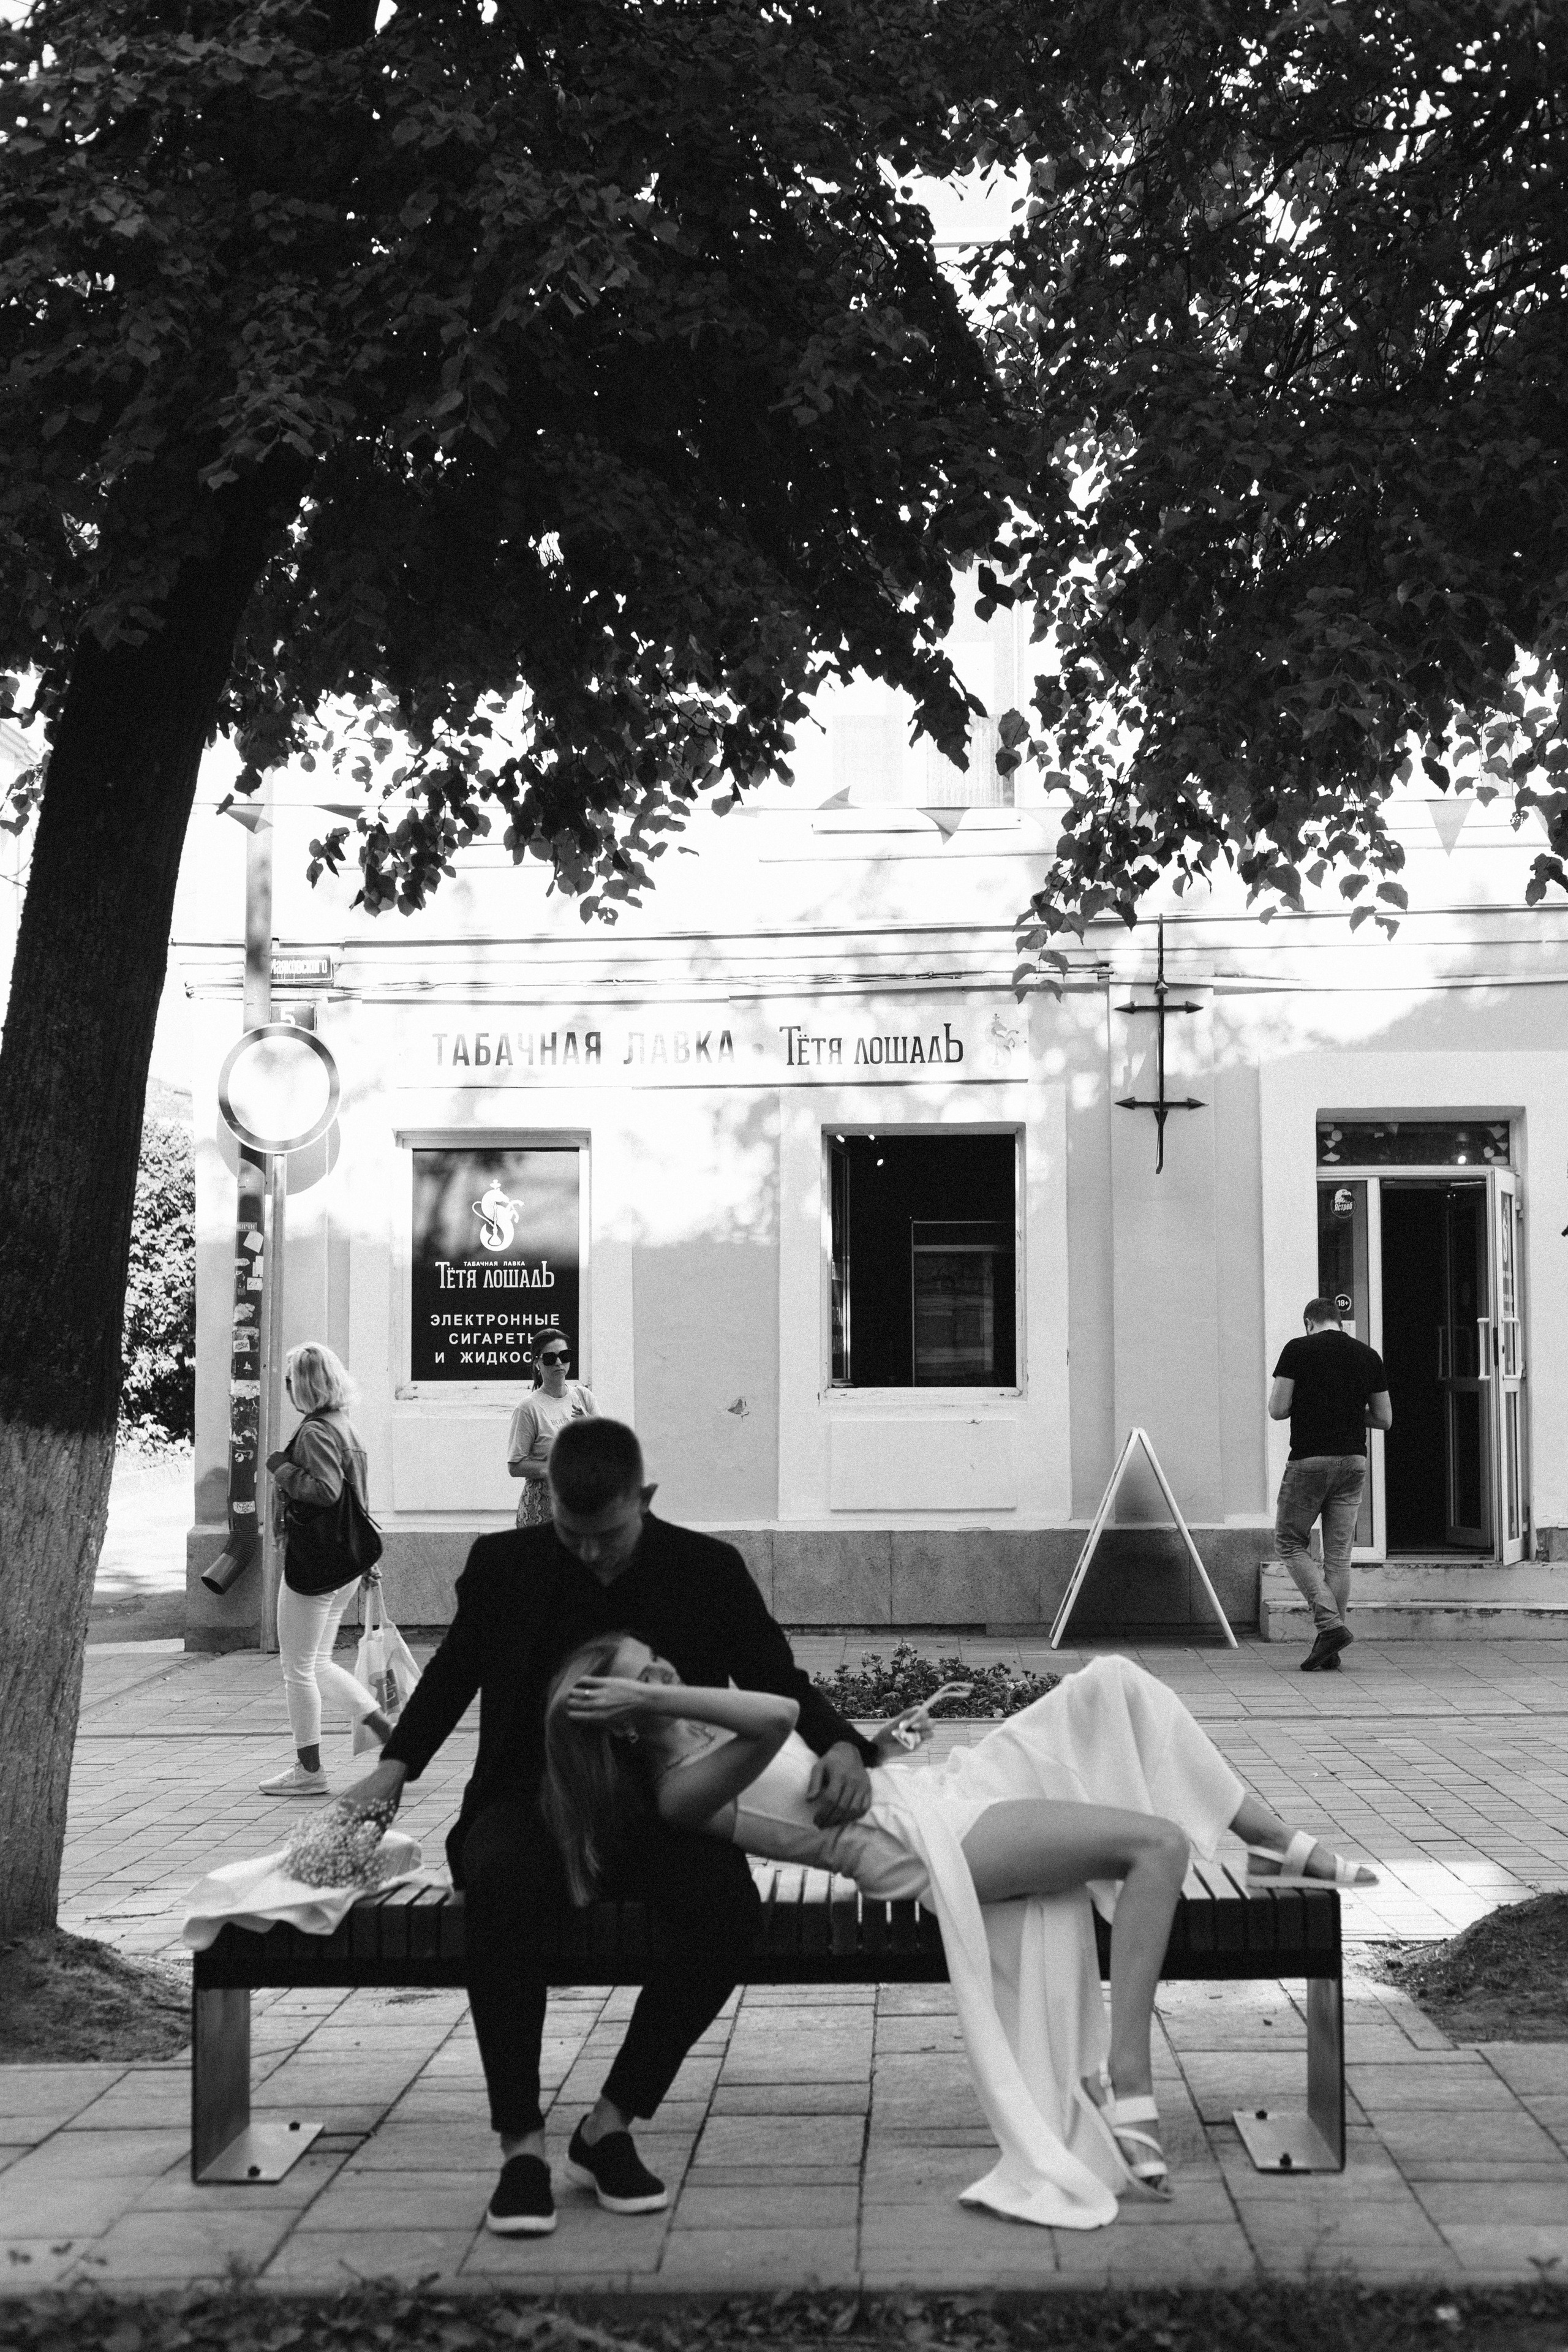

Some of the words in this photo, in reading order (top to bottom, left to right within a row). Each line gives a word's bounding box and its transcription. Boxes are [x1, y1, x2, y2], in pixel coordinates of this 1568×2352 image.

[432, 1031, 601, 1066] ТАБАЧНАЯ
[624, 1030, 735, 1065] ЛАВКА
[854, 1023, 963, 1064] ЛОШАДЬ
[1334, 1202, 1353, 1212] Ястреб
[483, 1261, 555, 1288] ЛОШАДЬ
[431, 1314, 559, 1325] ЭЛЕКТРОННЫЕ
[435, 1352, 445, 1363] И
[460, 1352, 533, 1365] ЖИДКОС
